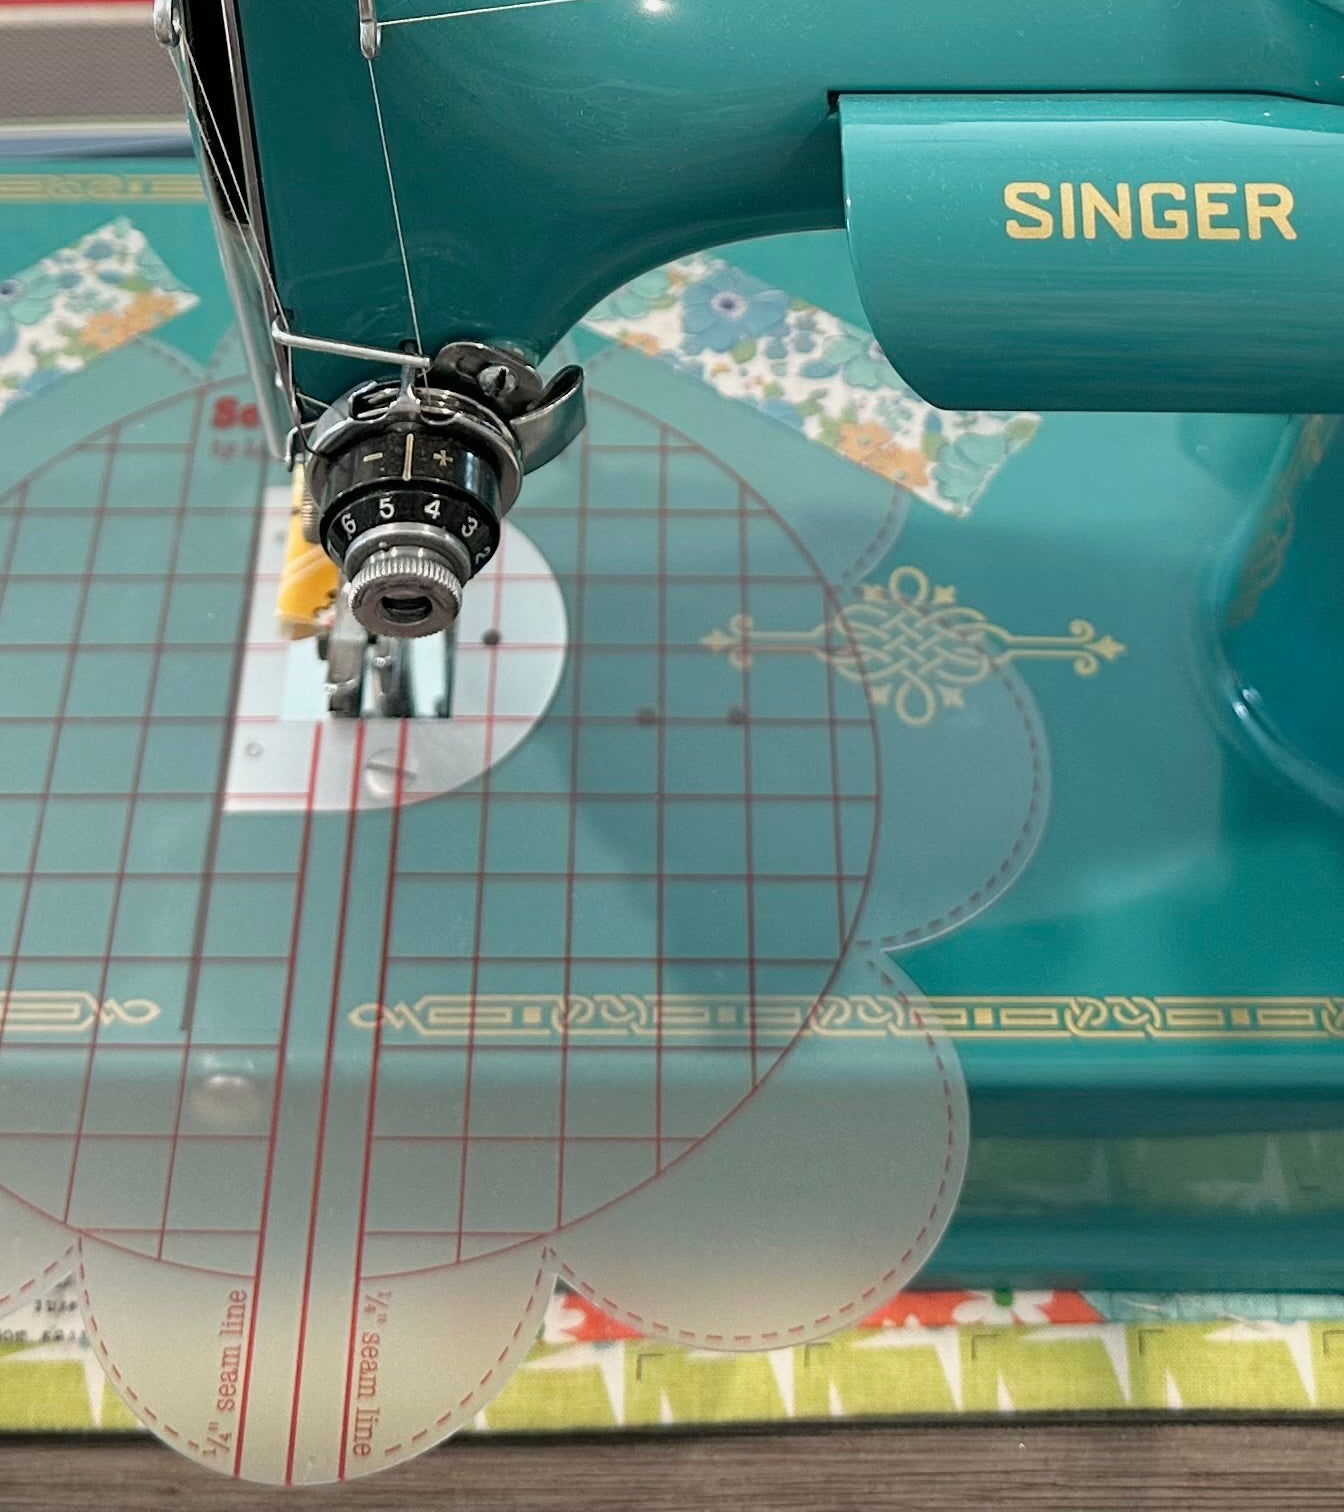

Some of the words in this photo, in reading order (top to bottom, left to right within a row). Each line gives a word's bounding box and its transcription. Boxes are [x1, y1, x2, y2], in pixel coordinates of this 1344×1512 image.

[1004, 181, 1298, 240] SINGER
[341, 513, 356, 540] 6
[379, 497, 395, 519] 5
[424, 500, 441, 519] 4
[461, 516, 478, 537] 3
[219, 1289, 248, 1337] line
[216, 1344, 241, 1412] seam
[358, 1332, 380, 1399] seam
[353, 1407, 380, 1458] line
